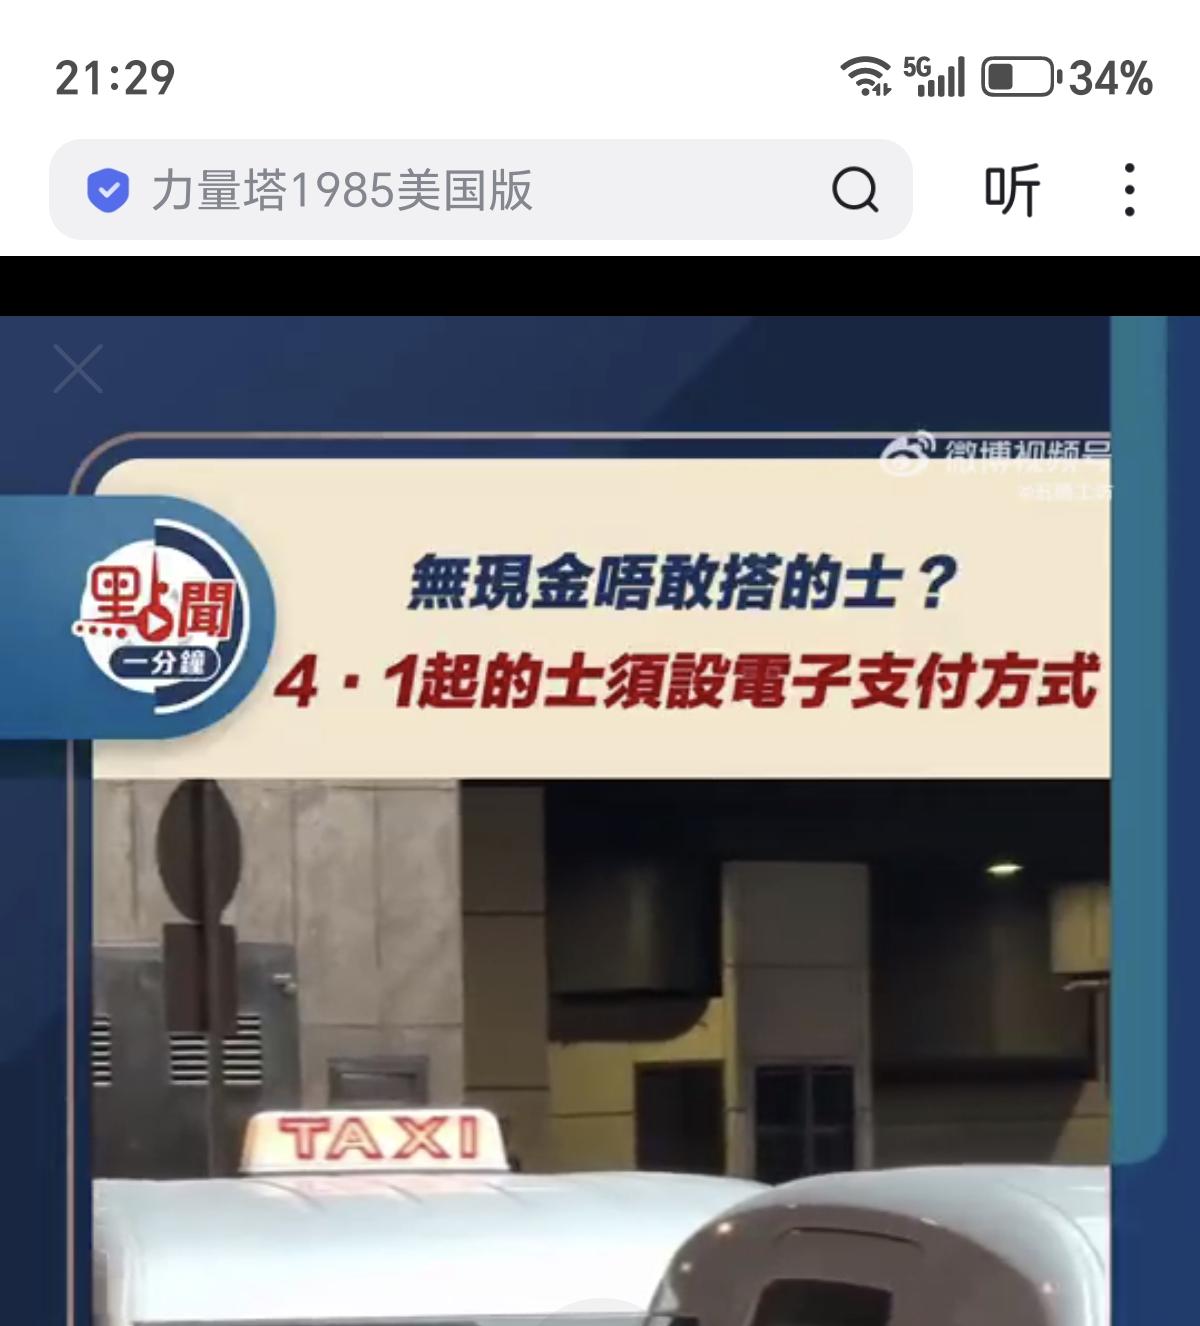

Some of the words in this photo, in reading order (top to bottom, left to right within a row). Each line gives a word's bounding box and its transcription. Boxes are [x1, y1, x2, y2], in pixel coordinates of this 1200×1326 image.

[55, 59, 175, 96] 21:29
[903, 55, 932, 77] 5G
[1069, 59, 1154, 96] 34%
[152, 167, 533, 212] 力量塔1985美国版
[985, 162, 1041, 218] 听
[279, 1116, 478, 1160] TAXI
